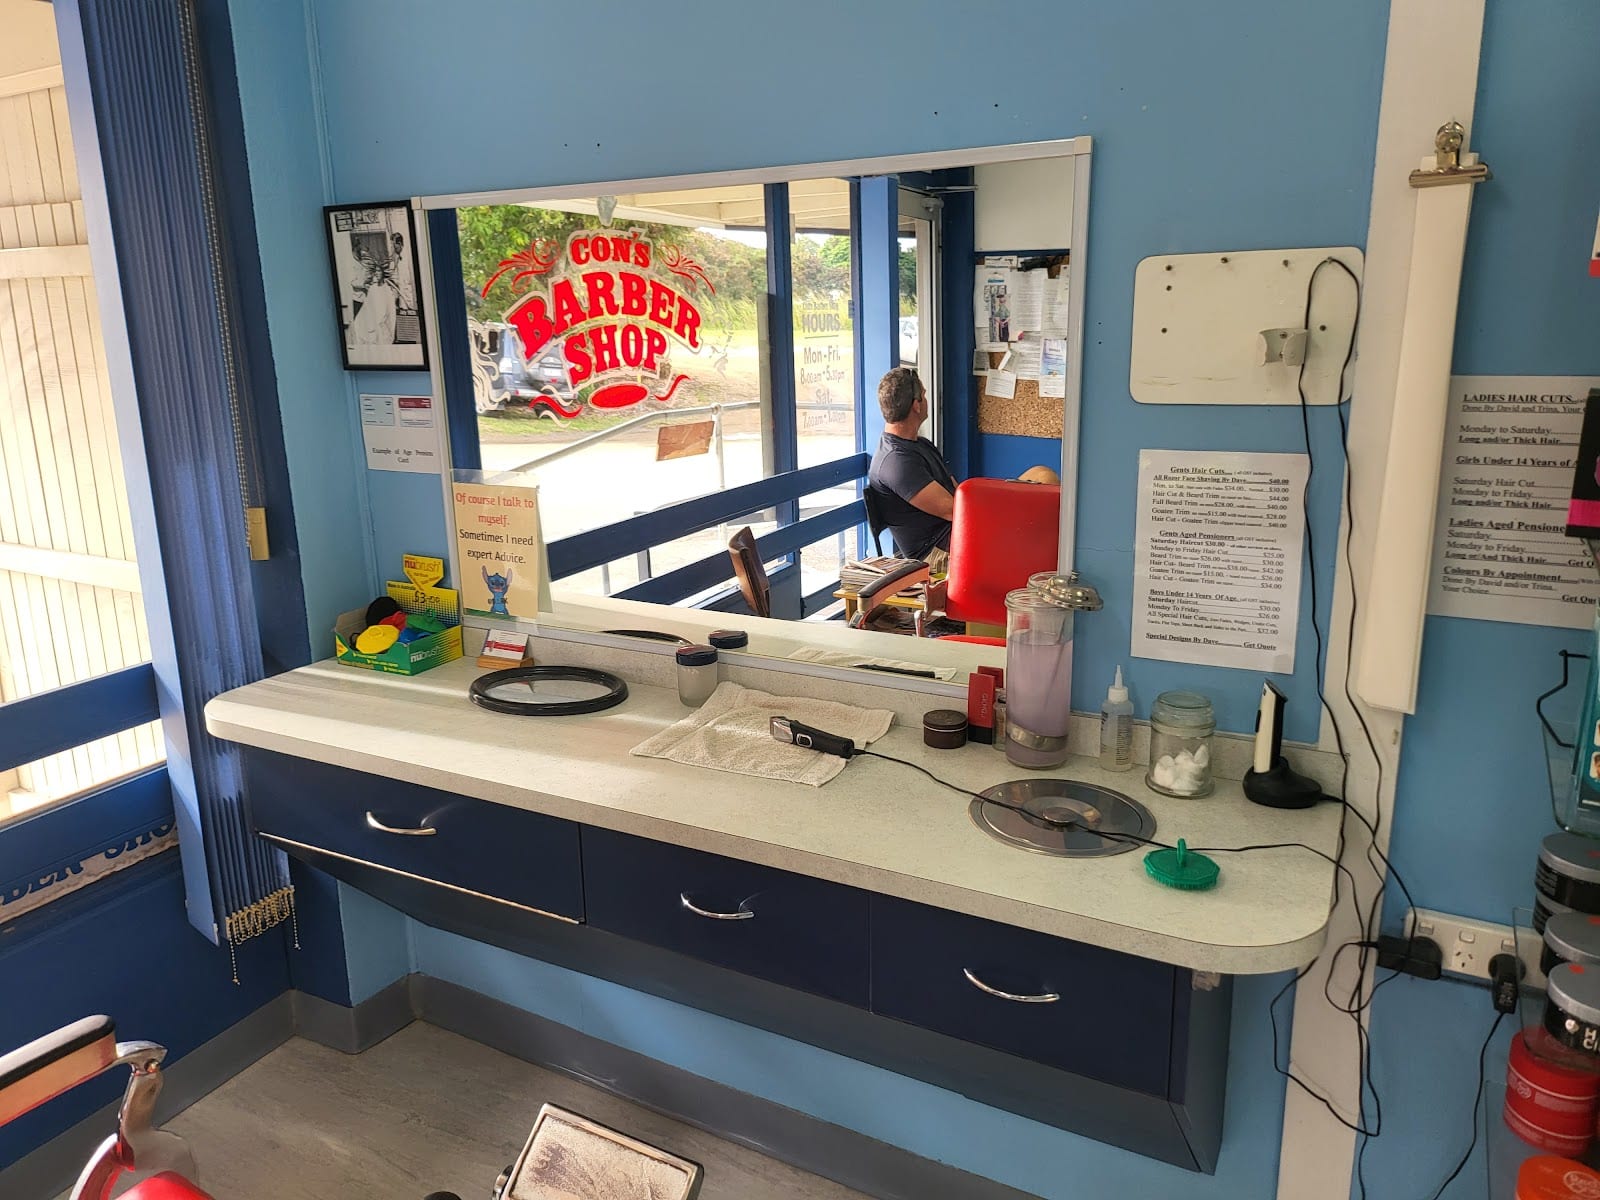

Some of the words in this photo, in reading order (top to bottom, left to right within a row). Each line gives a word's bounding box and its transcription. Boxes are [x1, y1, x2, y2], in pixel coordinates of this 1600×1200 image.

[570, 231, 650, 268] CON'S
[508, 271, 701, 360] BARBER
[802, 314, 840, 333] HOURS
[564, 324, 667, 385] SHOP
[1462, 394, 1505, 402] LADIES
[1508, 394, 1538, 402] HAIR
[1563, 406, 1582, 414] Your
[1460, 425, 1497, 434] Monday
[1500, 426, 1508, 434] to
[1459, 436, 1480, 444] Long
[1456, 456, 1480, 464] Girls
[1484, 457, 1513, 465] Under
[1530, 458, 1557, 466] Years
[1170, 466, 1190, 474] Gents
[1454, 478, 1493, 486] Saturday
[1496, 478, 1516, 486] Hair
[1452, 488, 1489, 498] Monday
[456, 492, 466, 506] Of
[468, 495, 496, 506] course
[502, 496, 522, 507] talk
[524, 498, 534, 508] to
[1452, 498, 1473, 506] Long
[1505, 500, 1529, 508] Thick
[478, 514, 510, 528] myself.
[1450, 518, 1484, 528] Ladies
[1486, 520, 1514, 530] Aged
[1518, 522, 1566, 532] Pensione
[460, 529, 504, 544] Sometimes
[511, 536, 534, 546] need
[1198, 532, 1234, 540] Pensioners
[1448, 530, 1490, 541] Saturday
[1446, 541, 1482, 551] Monday
[1484, 542, 1494, 550] to
[468, 549, 492, 560] expert
[494, 552, 526, 564] Advice.
[1500, 554, 1524, 562] Thick
[1526, 556, 1546, 564] Hair
[1568, 559, 1584, 567] Get
[1444, 566, 1480, 576] Colours
[1482, 569, 1495, 577] By
[1498, 570, 1562, 582] Appointment
[1442, 576, 1463, 584] Done
[1478, 578, 1501, 587] David
[1150, 588, 1164, 596] Boys
[1166, 590, 1184, 598] Under
[1195, 592, 1212, 600] Years
[1562, 594, 1578, 602] Get
[1148, 596, 1175, 604] Saturday
[1146, 632, 1168, 640] Special
[1168, 634, 1192, 642] Designs
[1193, 636, 1202, 644] By
